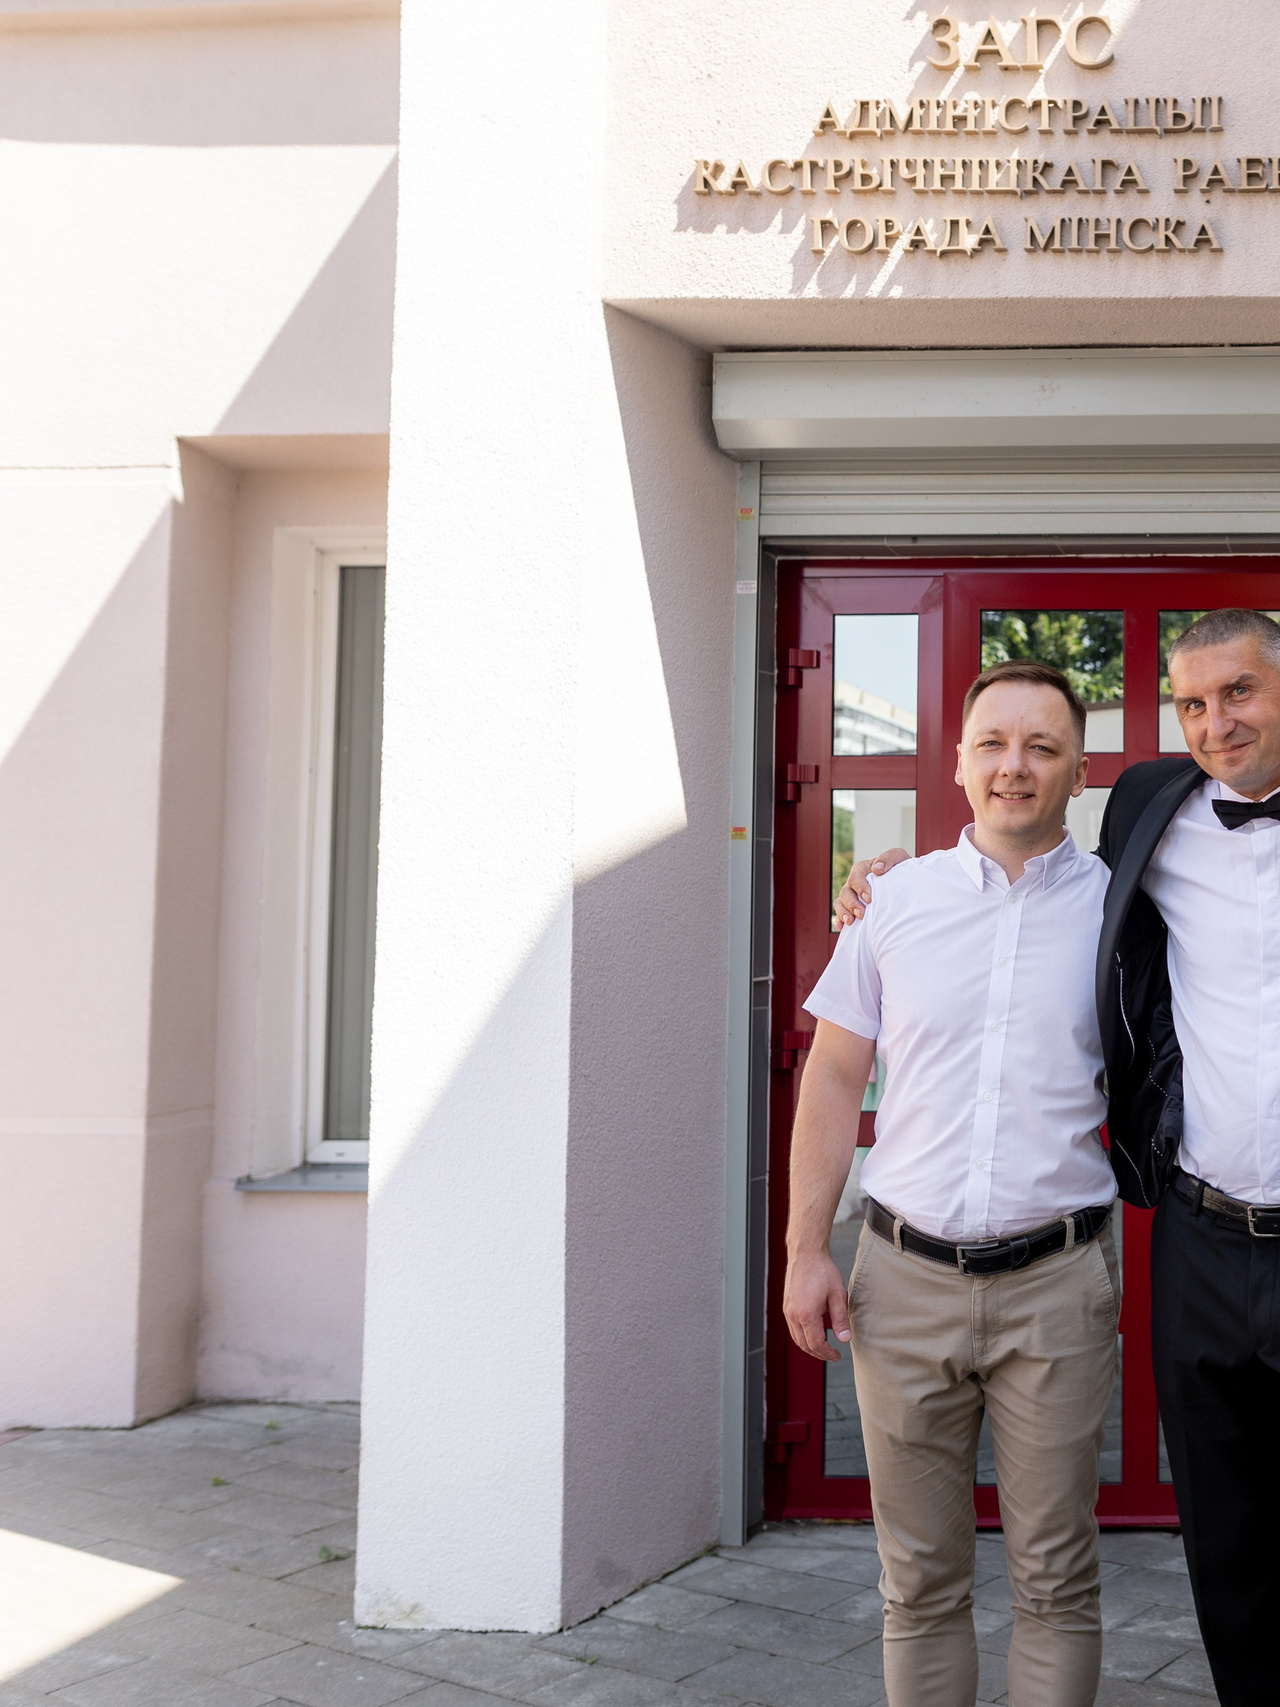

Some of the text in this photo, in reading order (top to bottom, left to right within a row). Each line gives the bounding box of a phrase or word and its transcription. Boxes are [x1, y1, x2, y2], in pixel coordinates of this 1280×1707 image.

[926, 15, 1114, 71] ЗАГС
[812, 95, 1224, 139] АДМІНІСТРАЦЫІ
[693, 157, 1150, 199] КАСТРЫЧНІЦКАГА
[810, 215, 1224, 258] ГОРАДА МІНСКА
